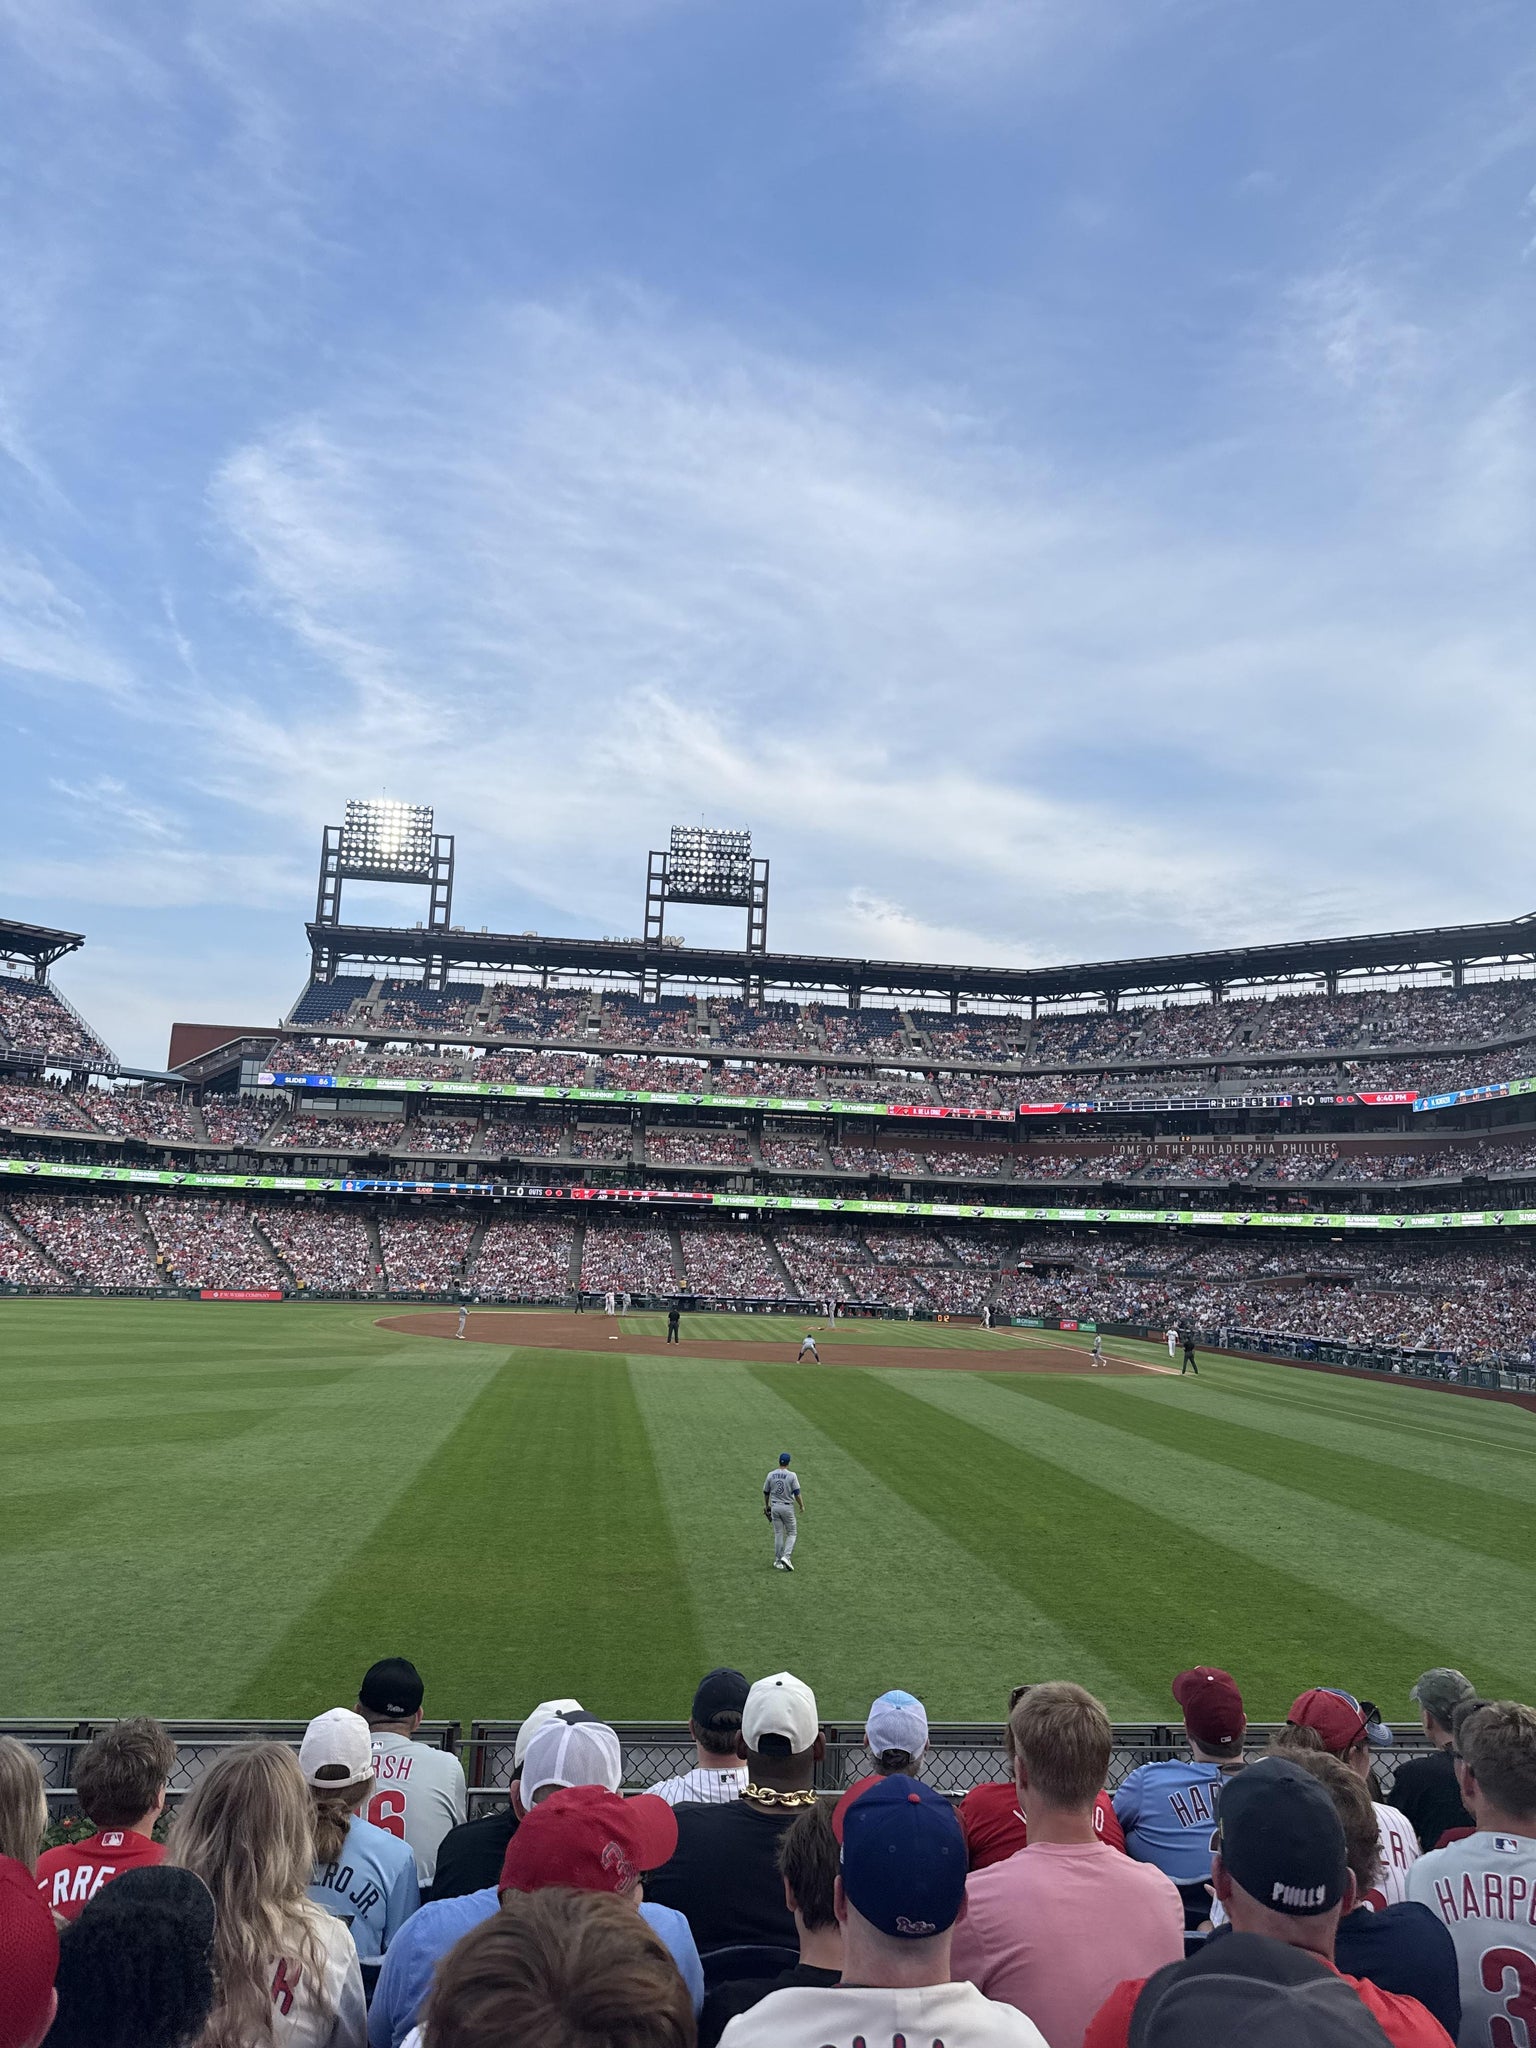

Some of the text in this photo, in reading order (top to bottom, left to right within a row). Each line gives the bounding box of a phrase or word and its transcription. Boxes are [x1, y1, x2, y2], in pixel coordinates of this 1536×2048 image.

[1147, 1145, 1159, 1154] OF
[1166, 1144, 1185, 1154] THE
[1192, 1144, 1275, 1154] PHILADELPHIA
[1283, 1143, 1337, 1153] PHILLIES
[775, 1480, 785, 1495] 3
[349, 1882, 380, 1919] JR.
